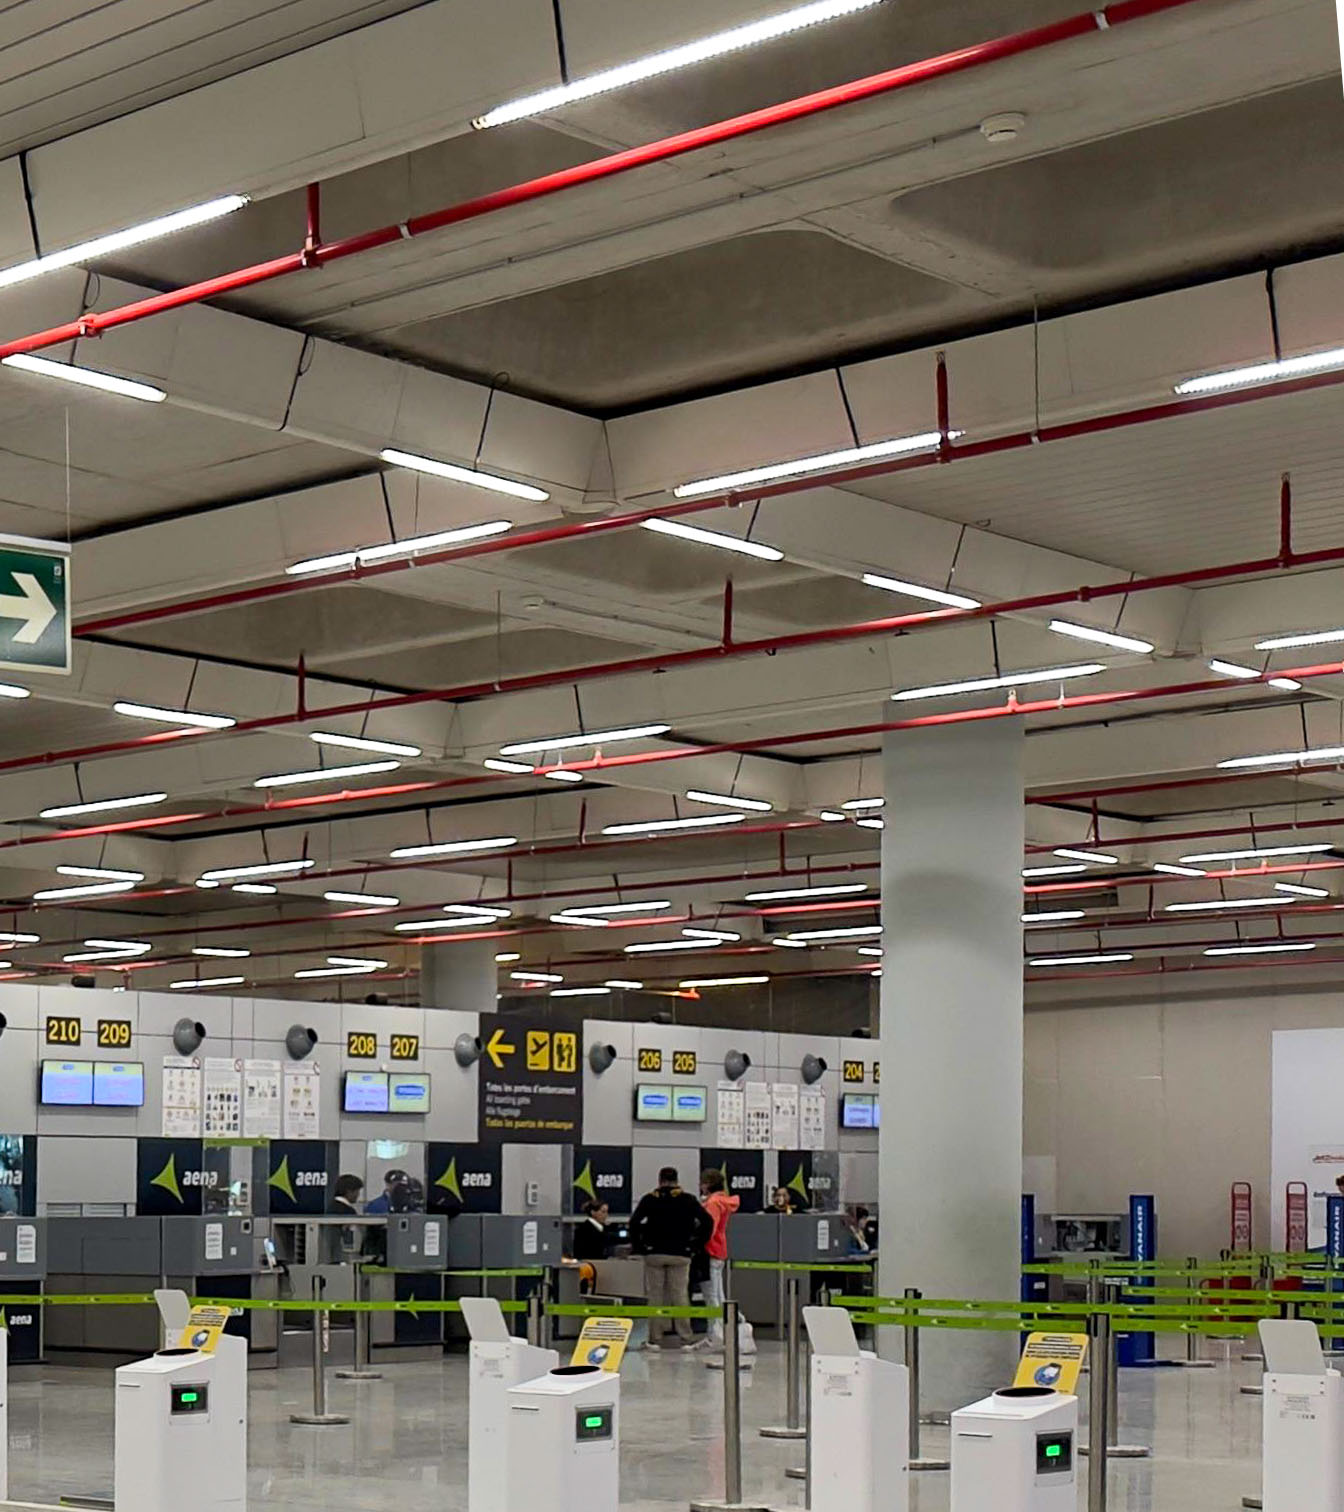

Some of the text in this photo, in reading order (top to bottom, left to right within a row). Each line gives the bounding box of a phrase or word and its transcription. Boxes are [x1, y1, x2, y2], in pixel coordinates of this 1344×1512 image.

[49, 1020, 79, 1042] 210
[100, 1024, 130, 1044] 209
[349, 1036, 375, 1055] 208
[392, 1038, 417, 1057] 207
[640, 1051, 661, 1069] 206
[675, 1054, 694, 1071] 205
[845, 1063, 863, 1079] 204
[183, 1171, 218, 1186] aena
[295, 1171, 328, 1186] aena
[462, 1172, 492, 1187] aena
[596, 1174, 624, 1188] aena
